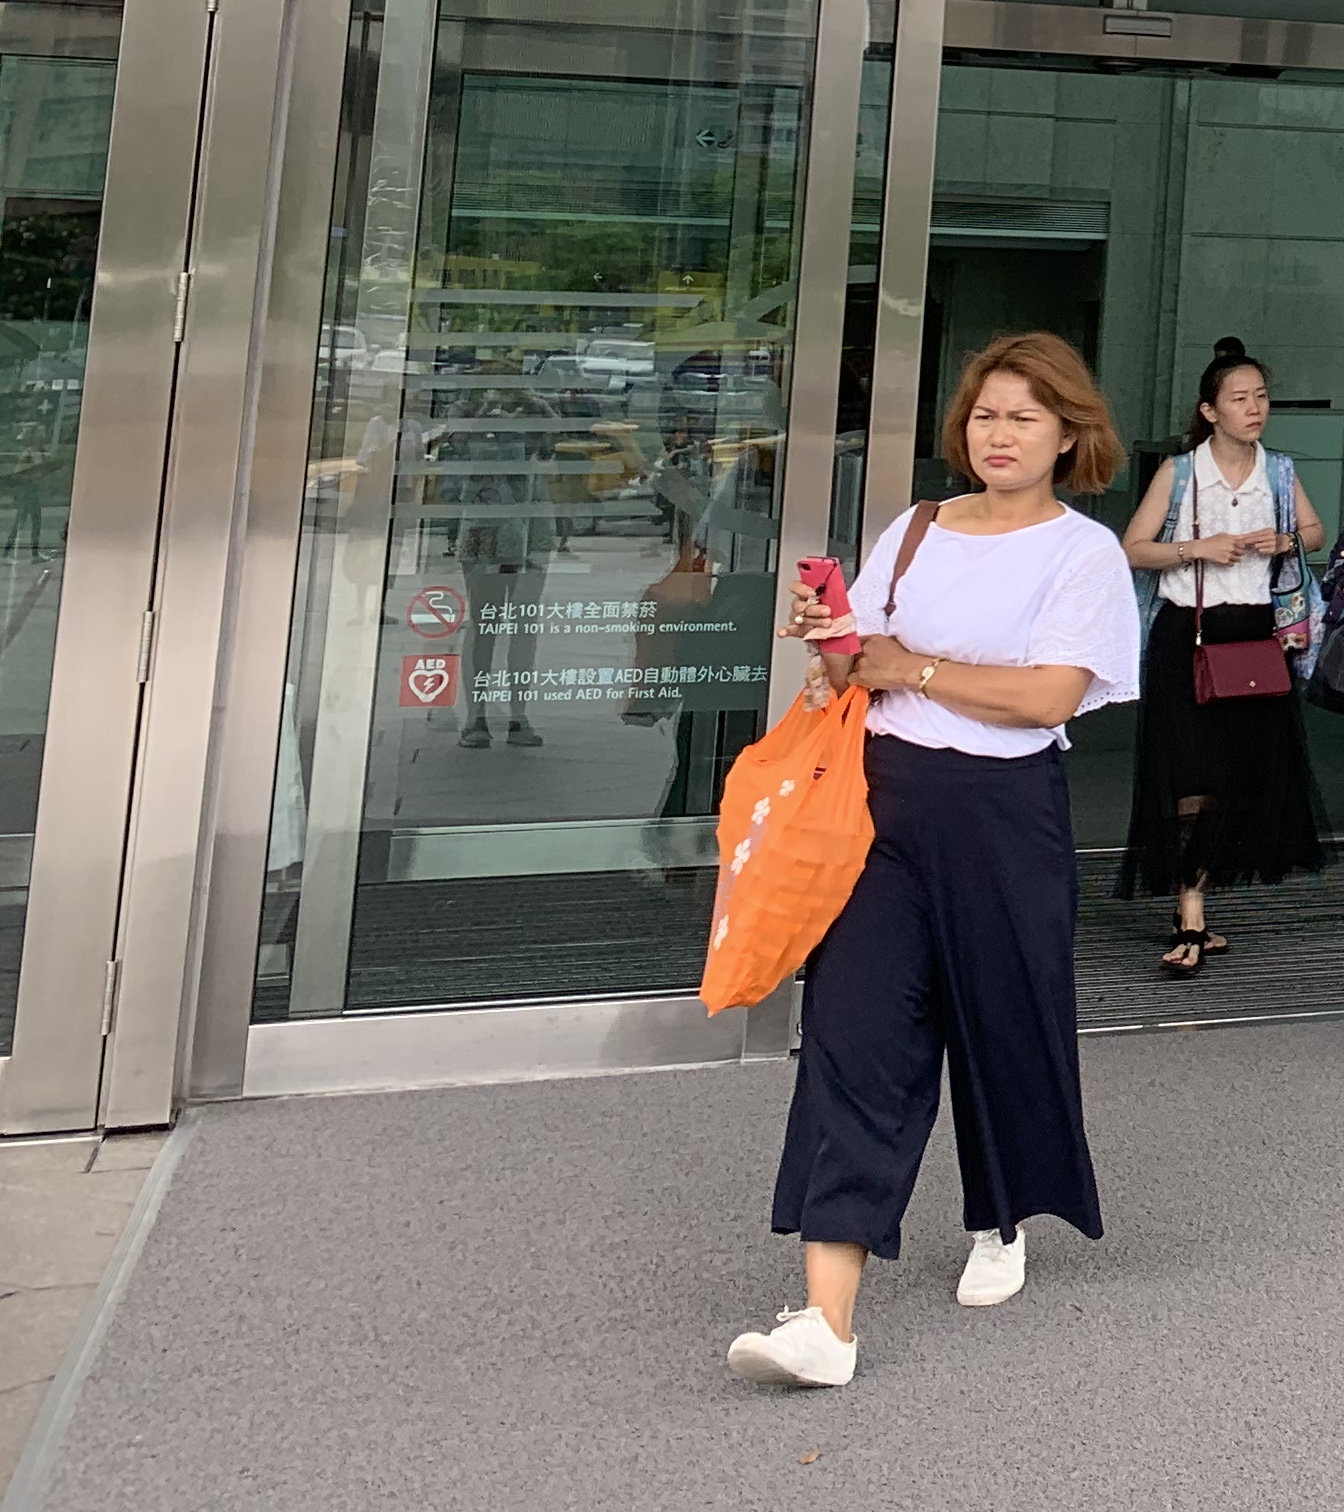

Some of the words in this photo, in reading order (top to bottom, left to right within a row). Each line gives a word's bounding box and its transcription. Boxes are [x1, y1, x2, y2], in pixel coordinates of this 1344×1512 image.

[480, 601, 658, 620] 台北101大樓全面禁菸
[478, 622, 518, 635] TAIPEI
[523, 622, 545, 635] 101
[550, 622, 560, 634] is
[563, 625, 571, 634] a
[575, 621, 655, 635] non-smoking
[658, 620, 737, 633] environment.
[414, 658, 447, 669] AED
[471, 690, 512, 703] TAIPEI
[517, 690, 538, 702] 101
[543, 689, 572, 701] used
[576, 688, 602, 700] AED
[606, 688, 624, 700] for
[628, 687, 655, 699] First
[657, 687, 682, 699] Aid.
